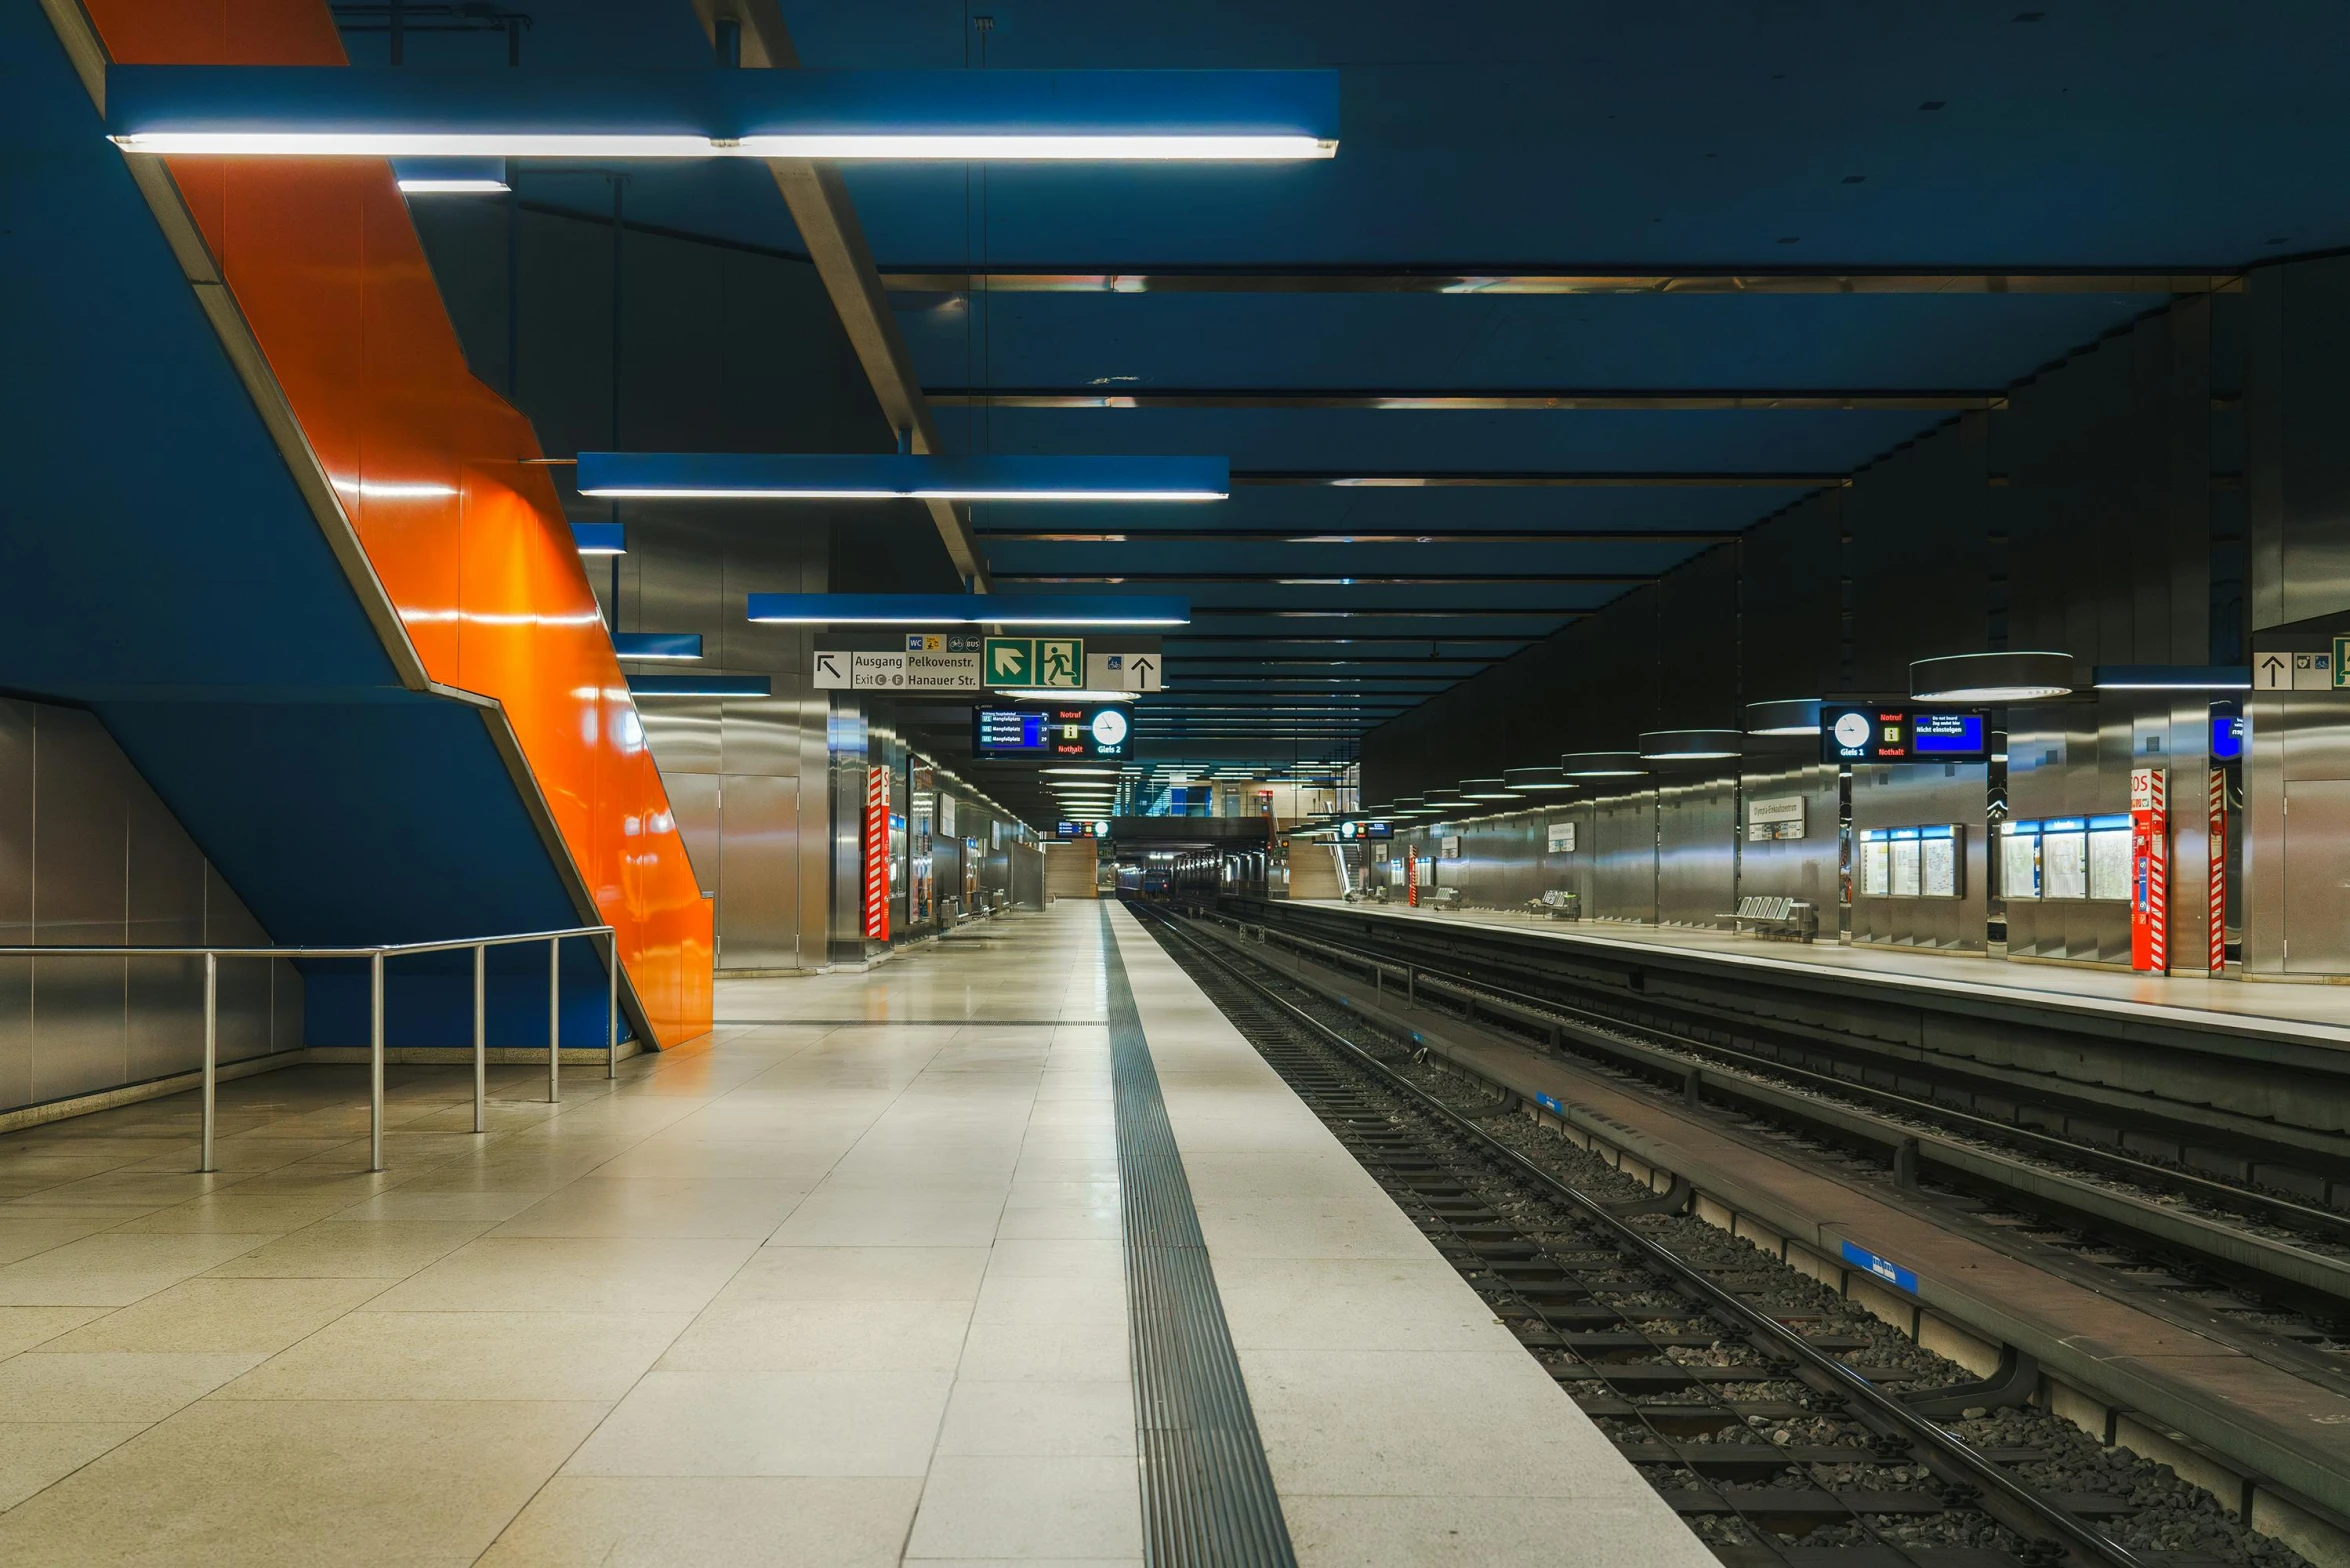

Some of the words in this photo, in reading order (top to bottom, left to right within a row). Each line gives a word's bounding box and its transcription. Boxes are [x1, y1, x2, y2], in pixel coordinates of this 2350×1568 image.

[909, 639, 922, 647] WC
[855, 656, 902, 668] Ausgang
[908, 656, 974, 668] Pelkovenstr.
[855, 674, 873, 684] Exit
[908, 676, 954, 686] Hanauer
[958, 675, 976, 686] Str.
